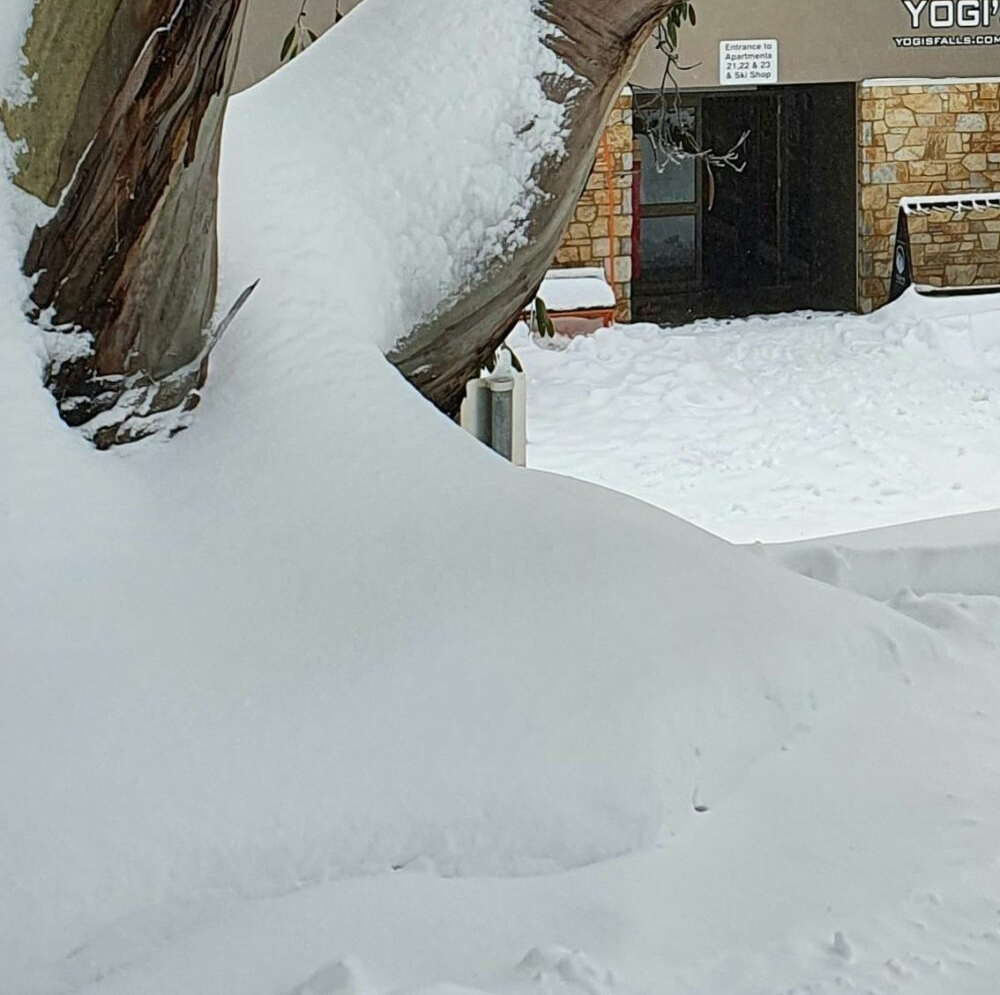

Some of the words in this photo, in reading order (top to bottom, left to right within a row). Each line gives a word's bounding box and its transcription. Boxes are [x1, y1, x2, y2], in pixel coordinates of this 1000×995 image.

[725, 43, 761, 51] Entrance
[725, 52, 773, 61] Apartments
[760, 61, 771, 69] 23
[734, 71, 748, 79] Ski
[749, 70, 772, 79] Shop
